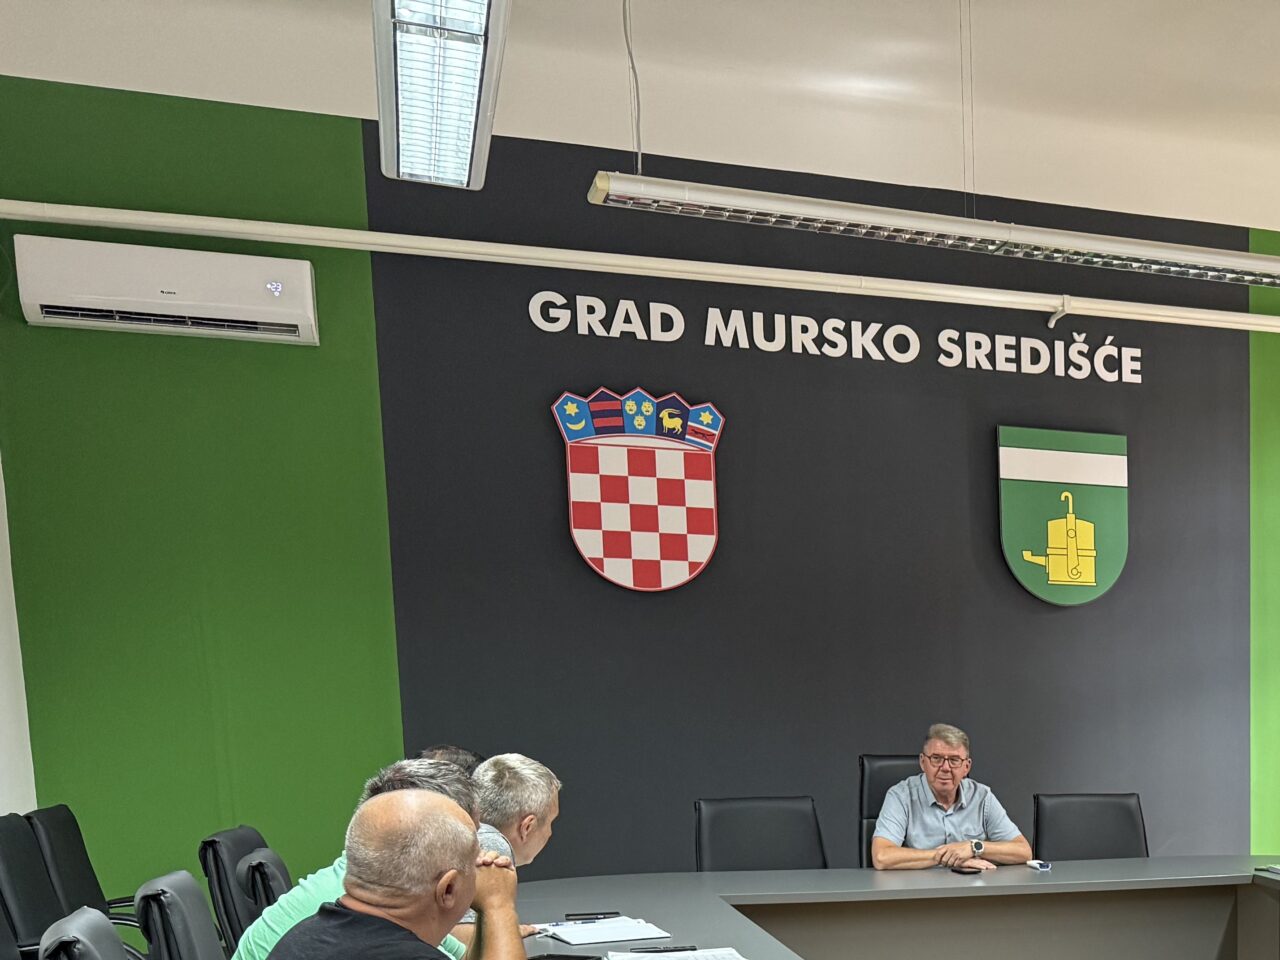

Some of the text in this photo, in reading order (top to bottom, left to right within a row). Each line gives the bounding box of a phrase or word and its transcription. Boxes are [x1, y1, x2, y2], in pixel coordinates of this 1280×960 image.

[528, 290, 1142, 384] GRAD MURSKO SREDIŠĆE
